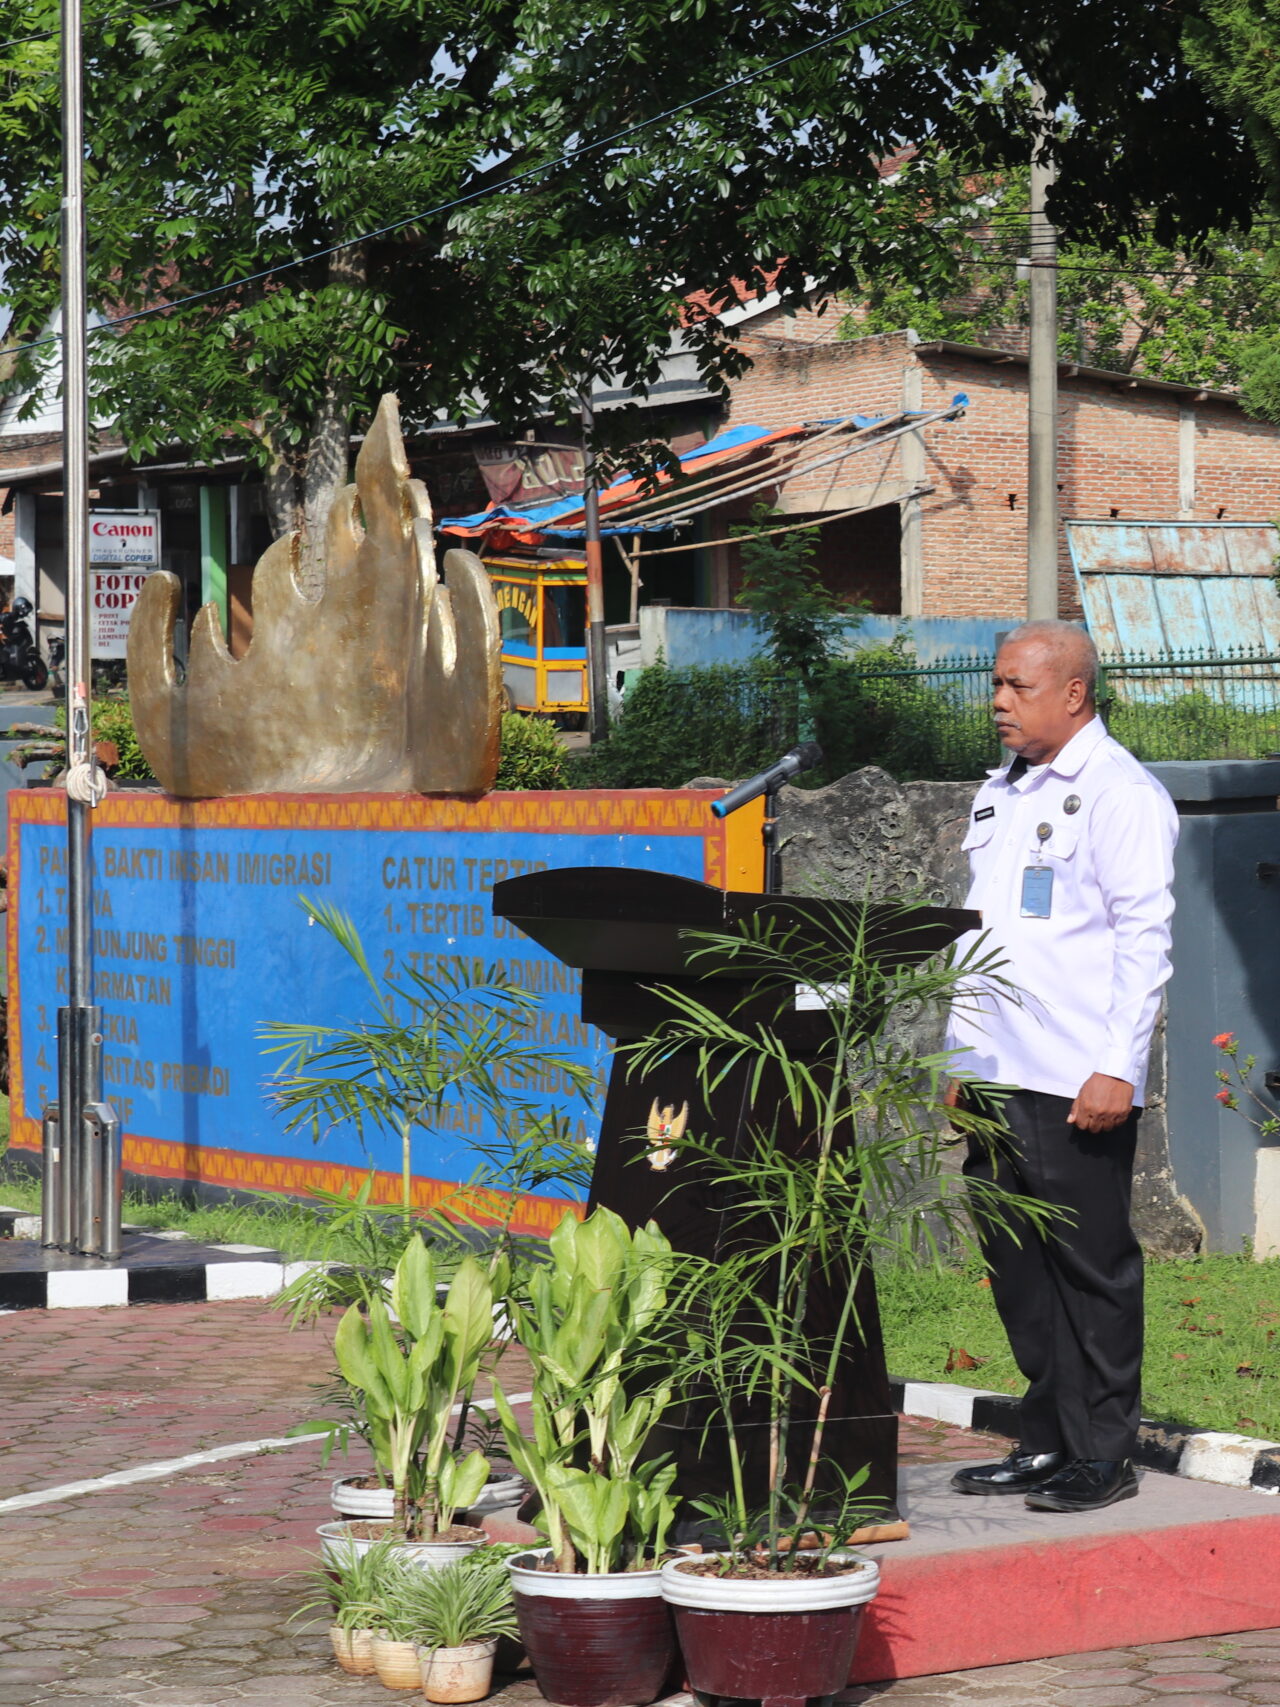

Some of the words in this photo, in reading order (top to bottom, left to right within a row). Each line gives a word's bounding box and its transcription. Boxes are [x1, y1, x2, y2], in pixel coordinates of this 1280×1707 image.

[93, 522, 153, 537] Canon
[93, 554, 122, 562] DIGITAL
[96, 575, 146, 591] FOTO
[95, 593, 139, 609] COP
[104, 848, 163, 880] BAKTI
[169, 851, 229, 882] INSAN
[236, 853, 331, 885] IMIGRASI
[382, 857, 457, 890] CATUR
[36, 888, 50, 915] 1.
[383, 904, 401, 933] 1.
[407, 902, 484, 936] TERTIB
[36, 926, 50, 953] 2.
[56, 928, 167, 961] MUNJUNG
[173, 936, 235, 968] TINGGI
[384, 949, 400, 980] 2.
[408, 951, 486, 986] TERTIB
[37, 1005, 50, 1031] 3.
[36, 1044, 51, 1072] 4.
[162, 1063, 230, 1096] PRIBADI
[410, 1097, 482, 1137] UMAH
